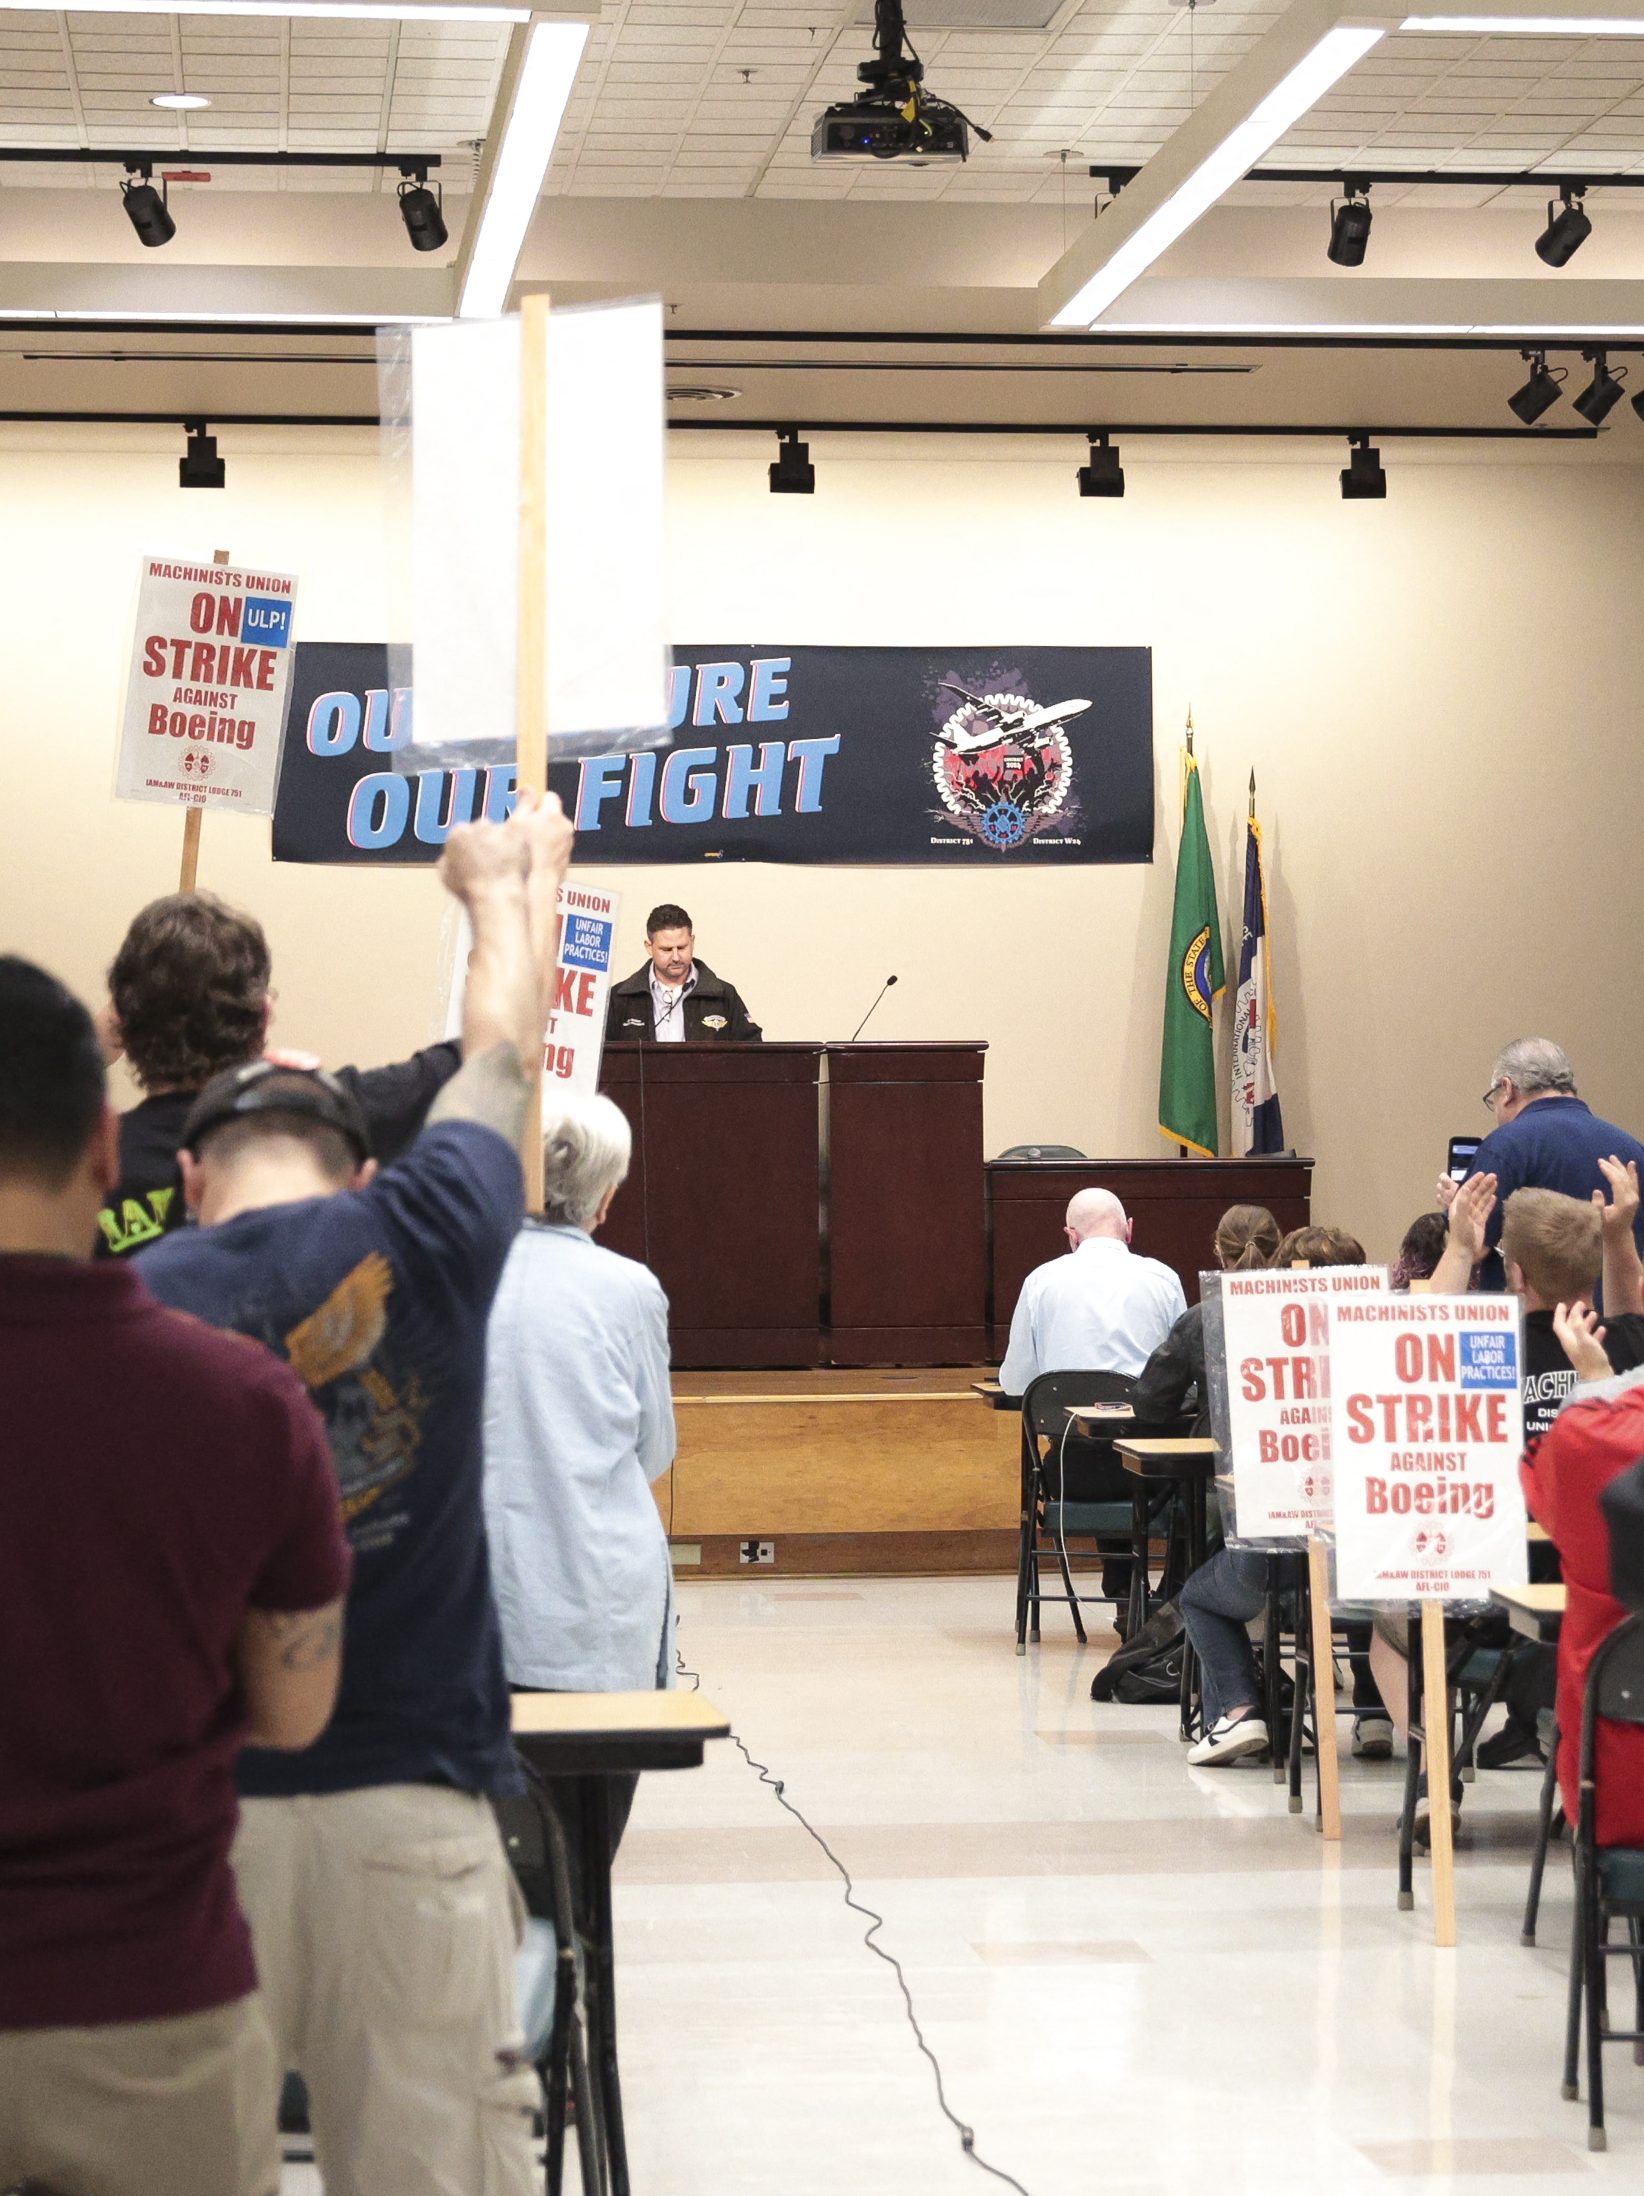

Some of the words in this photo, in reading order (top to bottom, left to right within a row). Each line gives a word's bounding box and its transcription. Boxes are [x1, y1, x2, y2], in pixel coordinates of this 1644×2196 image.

[150, 563, 242, 587] MACHINISTS
[245, 575, 291, 594] UNION
[190, 592, 243, 637] ON
[248, 608, 286, 630] ULP!
[143, 635, 277, 691] STRIKE
[173, 687, 238, 710] AGAINST
[148, 703, 256, 750] Boeing
[306, 687, 413, 757] OU
[176, 782, 207, 793] DISTRICT
[208, 786, 230, 797] LODGE
[230, 789, 242, 798] 751
[573, 734, 841, 831] FIGHT
[567, 890, 611, 914] UNION
[575, 918, 604, 935] UNFAIR
[574, 932, 602, 948] LABOR
[564, 943, 608, 964] PRACTICES!
[1186, 936, 1206, 967] STATE
[1185, 972, 1196, 995] THE
[1230, 1277, 1328, 1295] MACHINISTS
[1332, 1275, 1380, 1292] UNION
[1337, 1304, 1450, 1321] MACHINISTS
[1455, 1304, 1510, 1321] UNION
[1281, 1303, 1330, 1347] ON
[1470, 1335, 1506, 1349] UNFAIR
[1395, 1333, 1456, 1384] ON
[1472, 1350, 1504, 1364] LABOR
[1240, 1355, 1331, 1402] STRI
[1461, 1366, 1516, 1380] PRACTICES!
[1280, 1406, 1331, 1425] AGAIN
[1346, 1393, 1508, 1444] STRIKE
[1537, 1408, 1559, 1418] DIS
[1526, 1421, 1551, 1432] UNI
[1259, 1427, 1331, 1463] Boei
[1390, 1452, 1467, 1472] AGAINST
[1365, 1476, 1494, 1519] Boeing
[1410, 1570, 1448, 1579] DISTRICT
[1450, 1570, 1475, 1579] LODGE
[1478, 1570, 1491, 1579] 751
[1415, 1582, 1450, 1592] AFL-CIO
